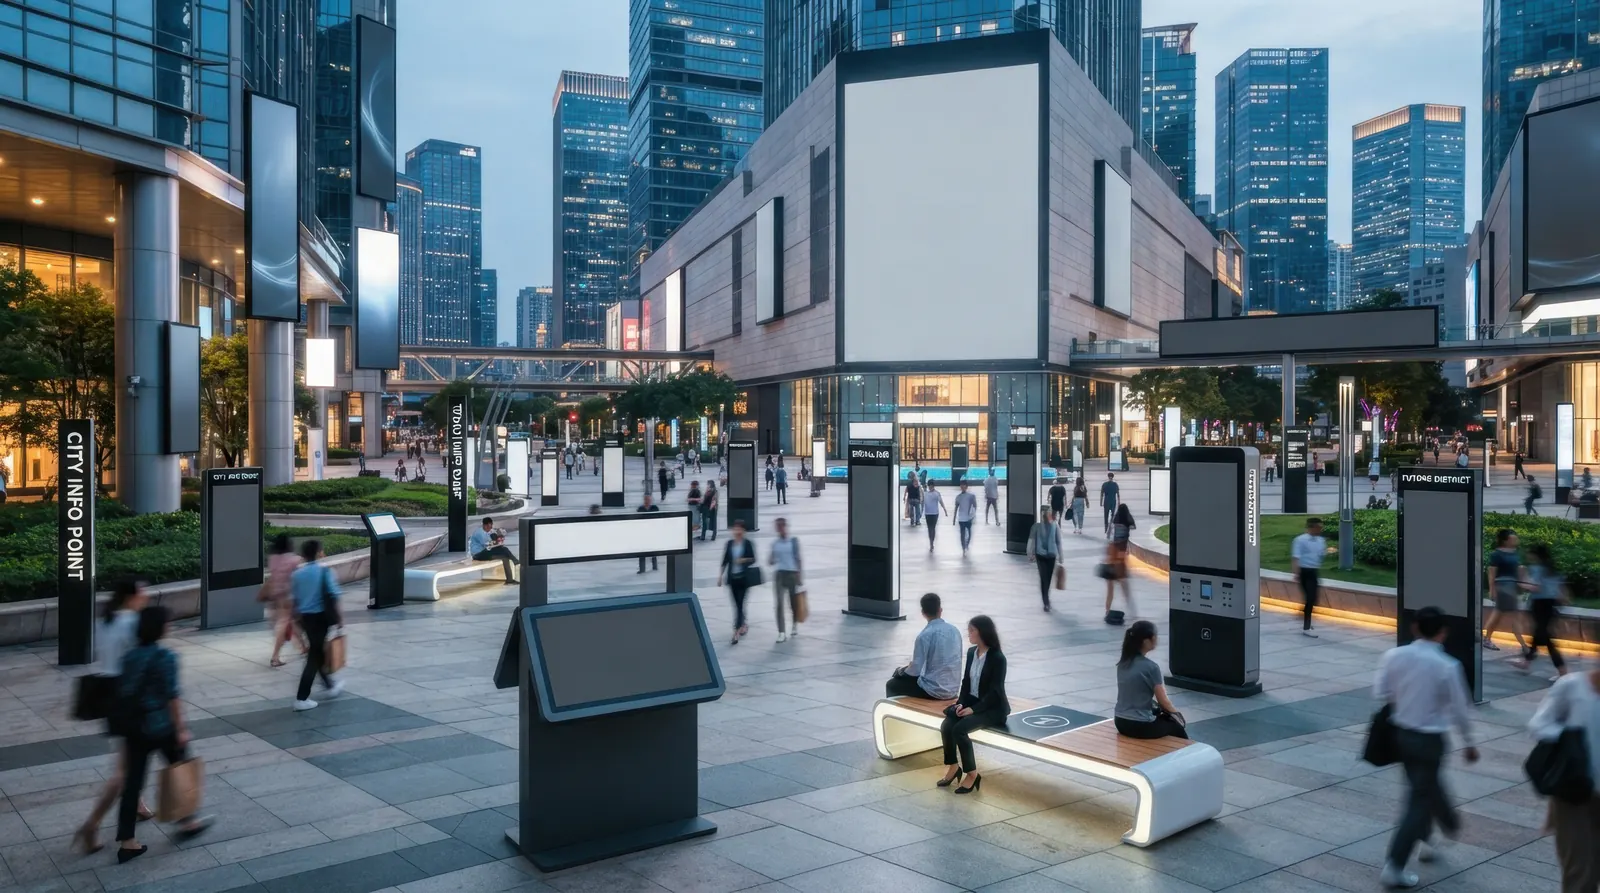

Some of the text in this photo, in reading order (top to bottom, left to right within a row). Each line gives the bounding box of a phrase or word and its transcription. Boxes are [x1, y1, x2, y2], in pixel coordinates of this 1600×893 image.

[66, 431, 84, 581] CITY INFO POINT
